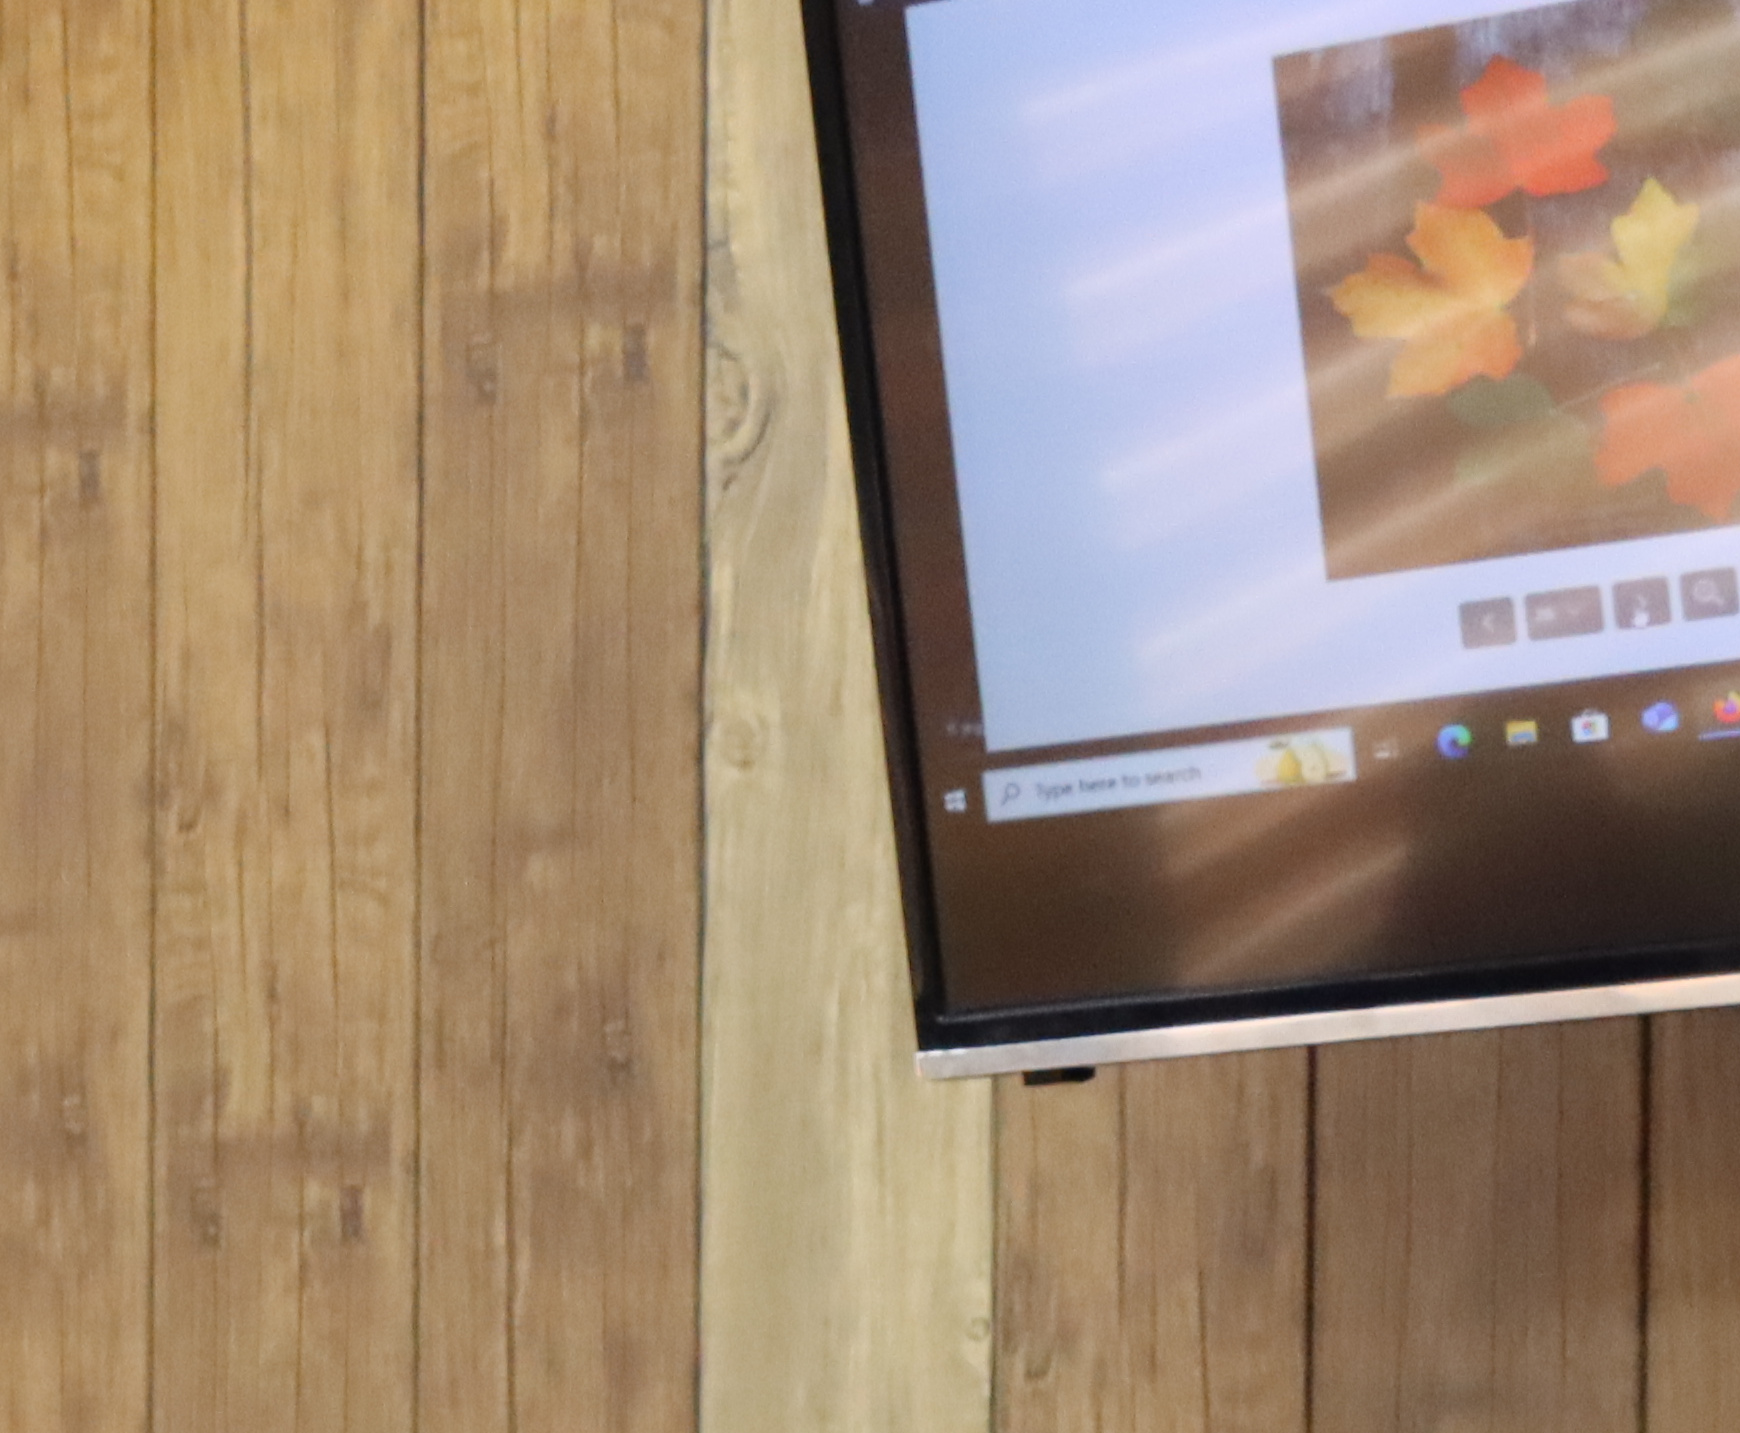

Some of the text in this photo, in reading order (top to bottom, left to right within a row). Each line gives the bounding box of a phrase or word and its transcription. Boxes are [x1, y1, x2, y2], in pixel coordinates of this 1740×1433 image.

[1036, 766, 1202, 802] Type here to search
